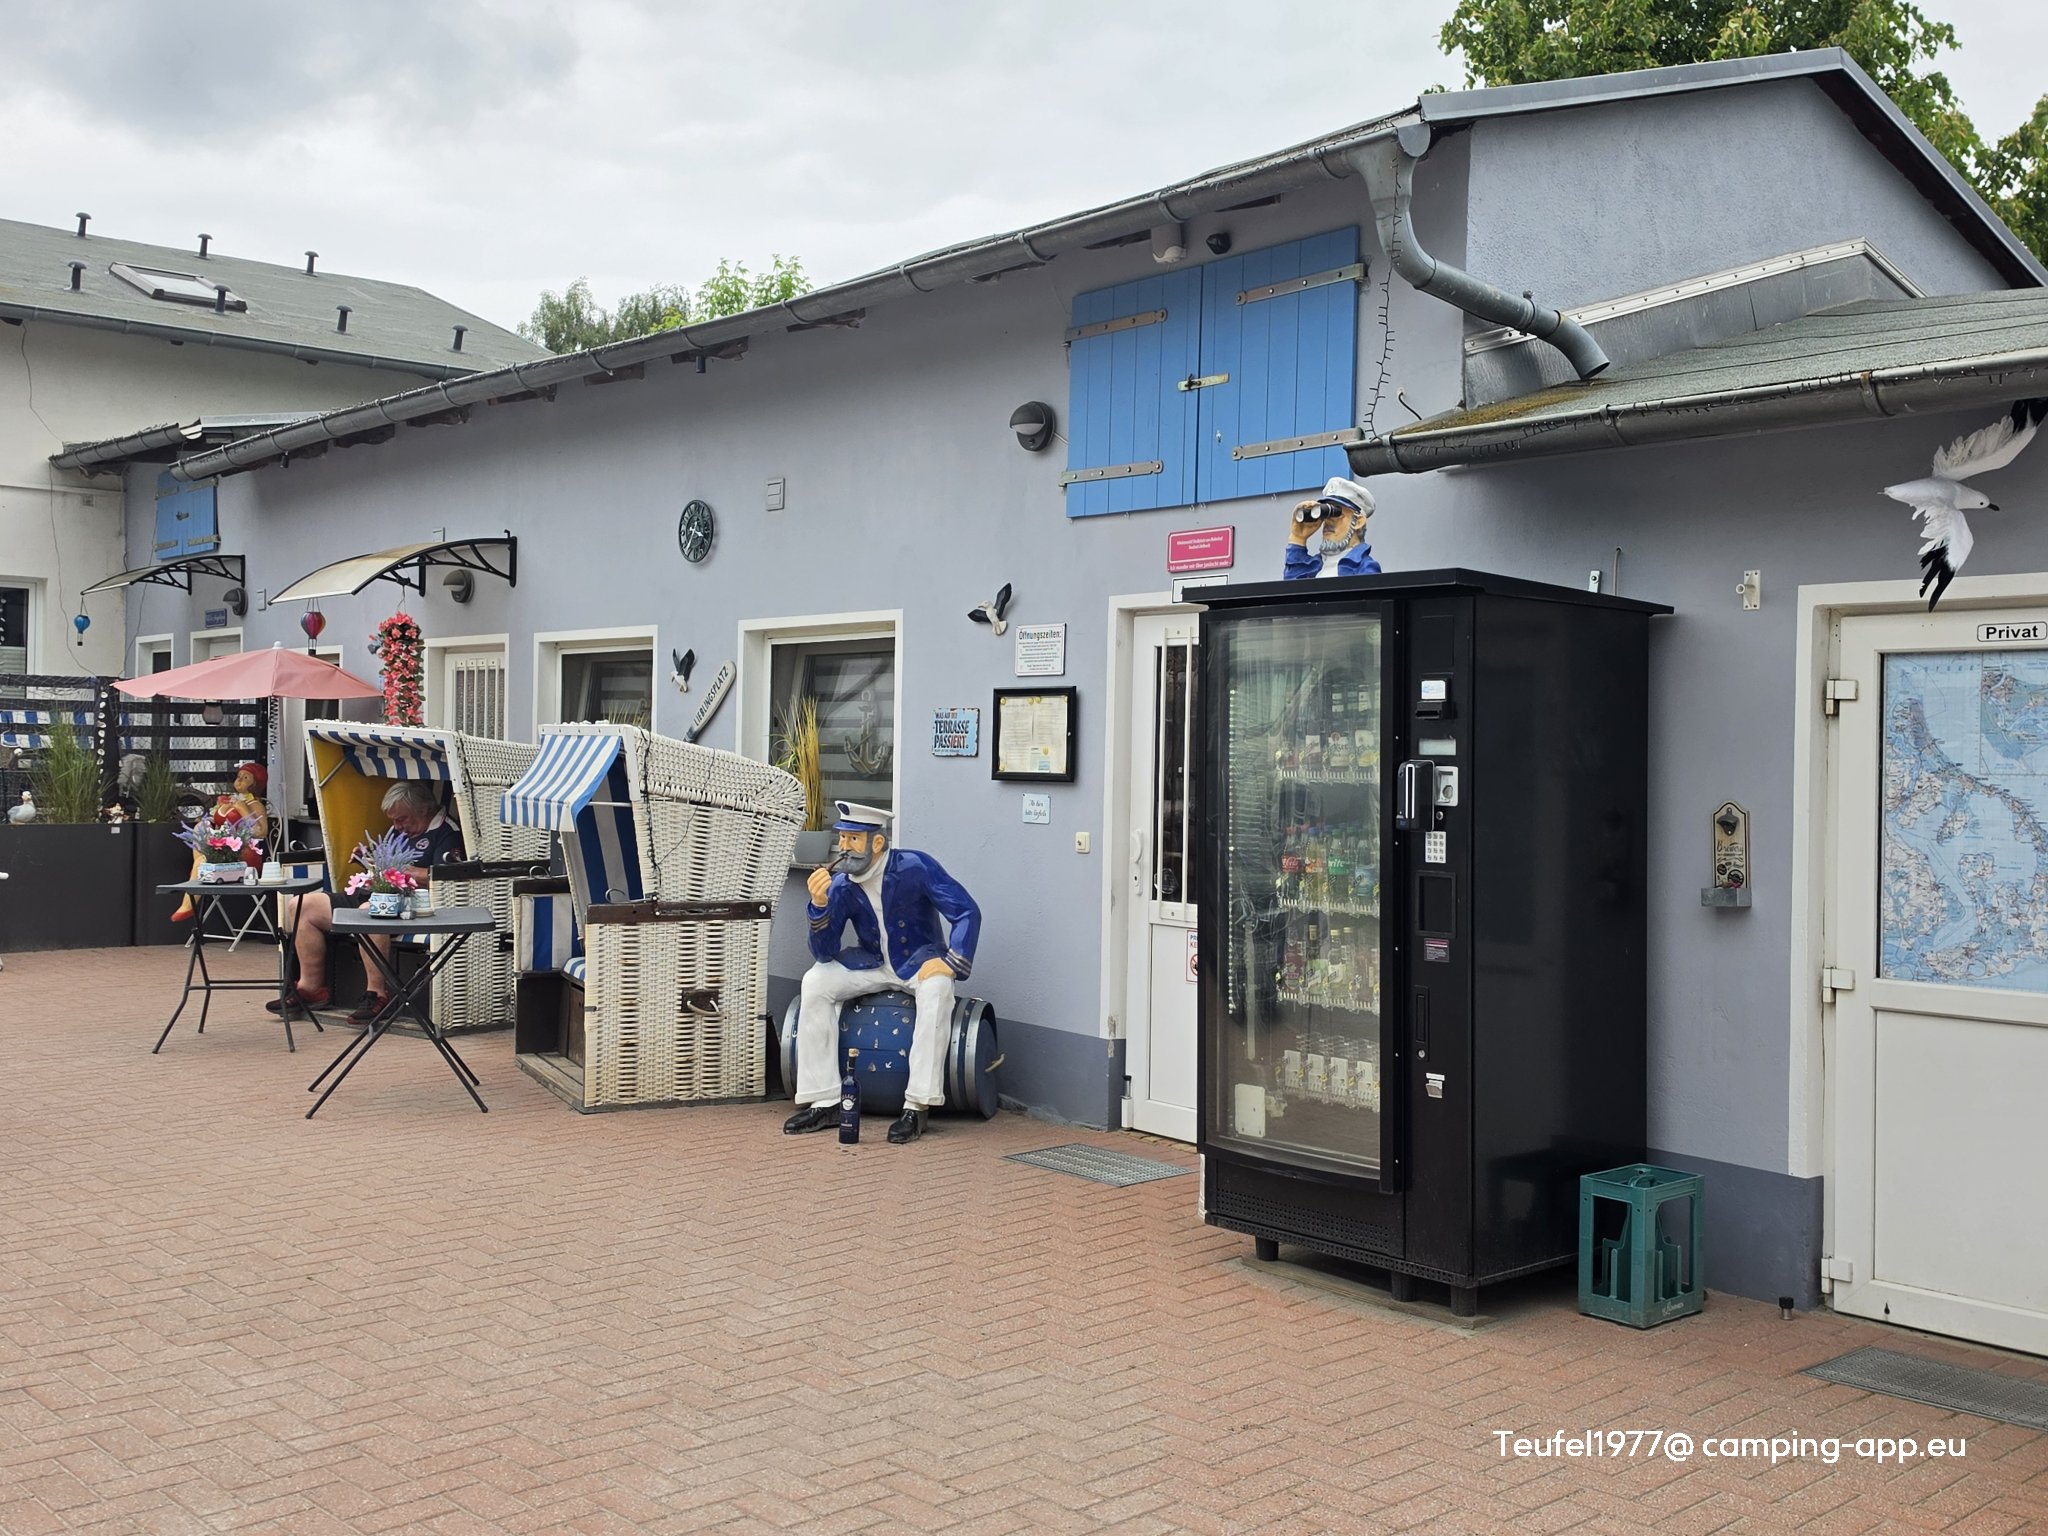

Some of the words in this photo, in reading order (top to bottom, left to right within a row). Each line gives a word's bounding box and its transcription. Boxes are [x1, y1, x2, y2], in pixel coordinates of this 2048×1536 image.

[1986, 625, 2038, 639] Privat
[693, 665, 729, 726] LIEBLINGSPLATZ
[934, 720, 970, 734] TERRASSE
